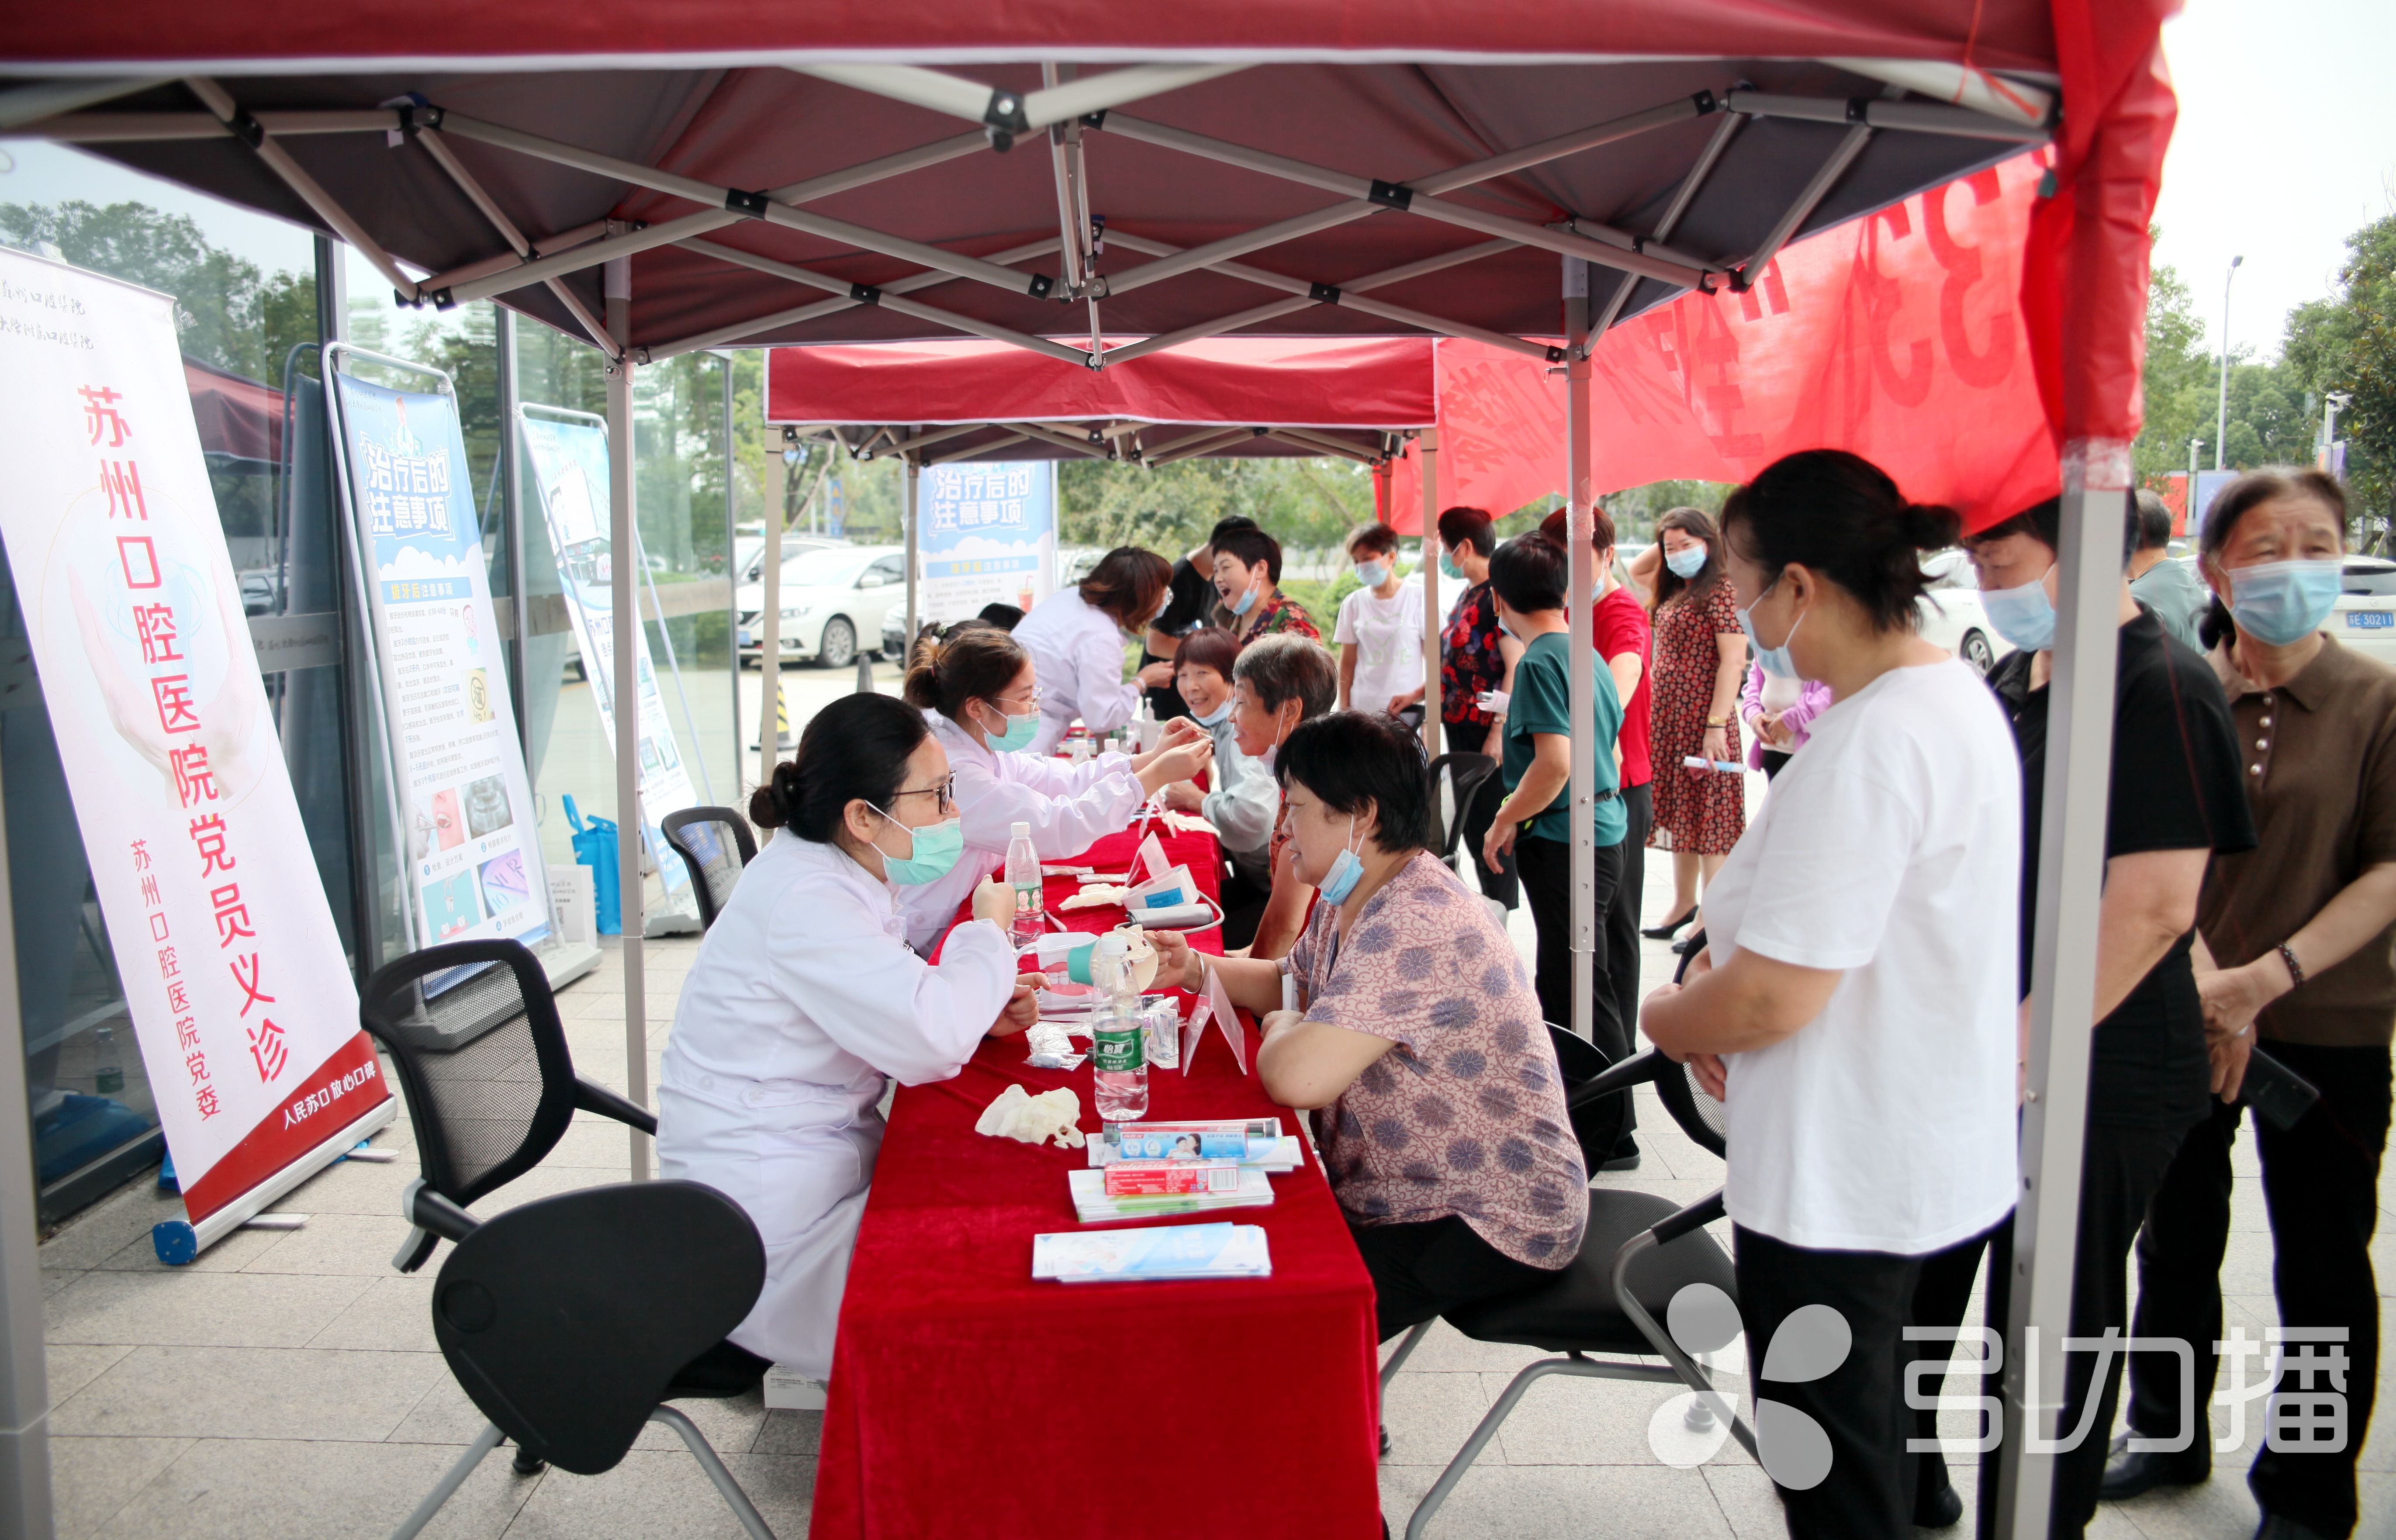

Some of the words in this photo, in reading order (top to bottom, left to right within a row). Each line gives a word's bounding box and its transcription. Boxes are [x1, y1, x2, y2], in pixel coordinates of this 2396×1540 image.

[367, 442, 449, 493] 治疗后的
[936, 466, 1031, 500] 治疗后的
[370, 492, 448, 532] 注意事项
[934, 499, 1022, 528] 注意事项
[391, 582, 453, 600] 拔牙后注意事项
[77, 384, 289, 1084] 苏州口腔医院党员义诊
[130, 838, 222, 1122] 苏州口腔医院党委
[285, 1094, 330, 1130] 人民苏口
[330, 1060, 376, 1100] 放心口碑
